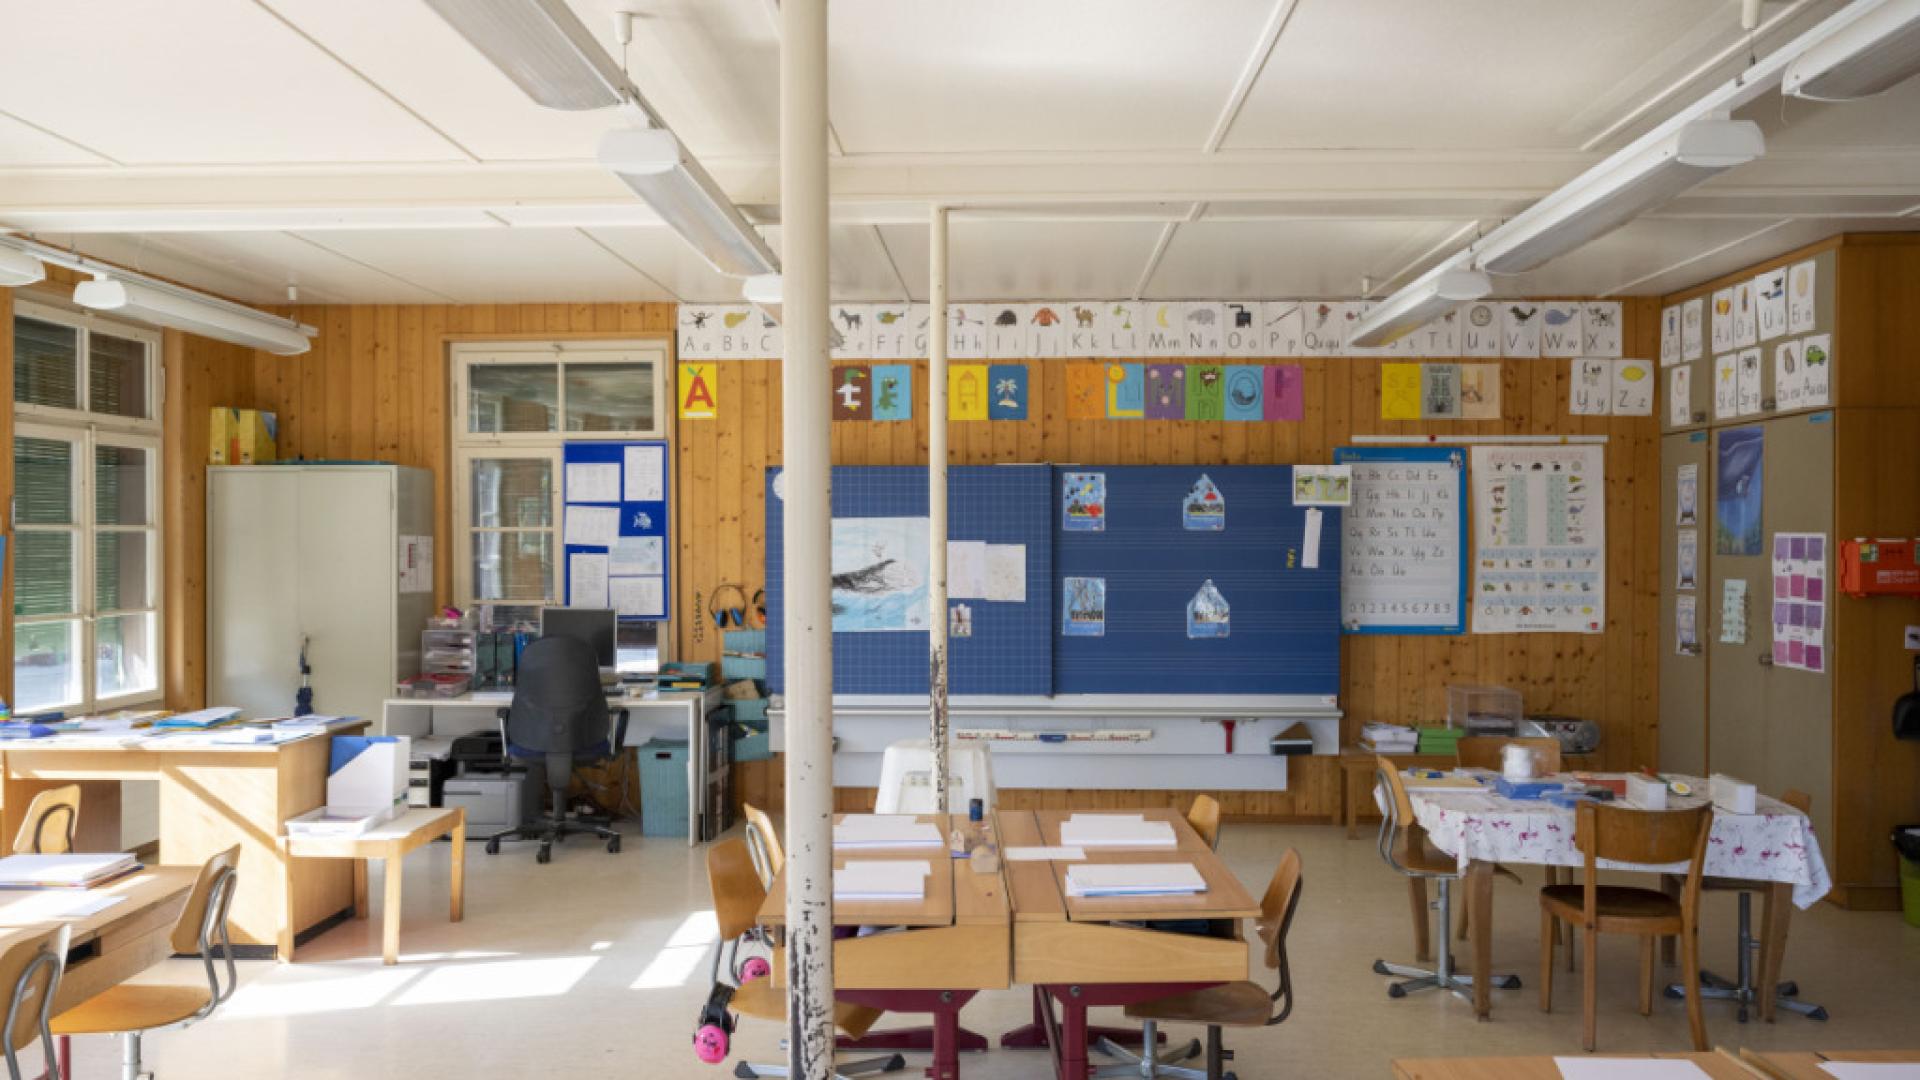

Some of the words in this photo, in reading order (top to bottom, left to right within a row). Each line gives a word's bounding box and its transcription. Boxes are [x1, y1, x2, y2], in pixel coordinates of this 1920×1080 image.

[684, 335, 695, 352] A
[723, 335, 732, 352] B
[760, 333, 771, 352] C
[877, 334, 886, 352] F
[953, 333, 965, 352] H
[1072, 332, 1082, 350] K
[1111, 332, 1121, 350] L
[1189, 332, 1203, 350] N
[1270, 331, 1280, 349] P
[1427, 331, 1439, 350] T
[1466, 331, 1479, 350] U
[1544, 332, 1562, 350] W
[684, 376, 715, 409] A
[1618, 389, 1629, 408] Z
